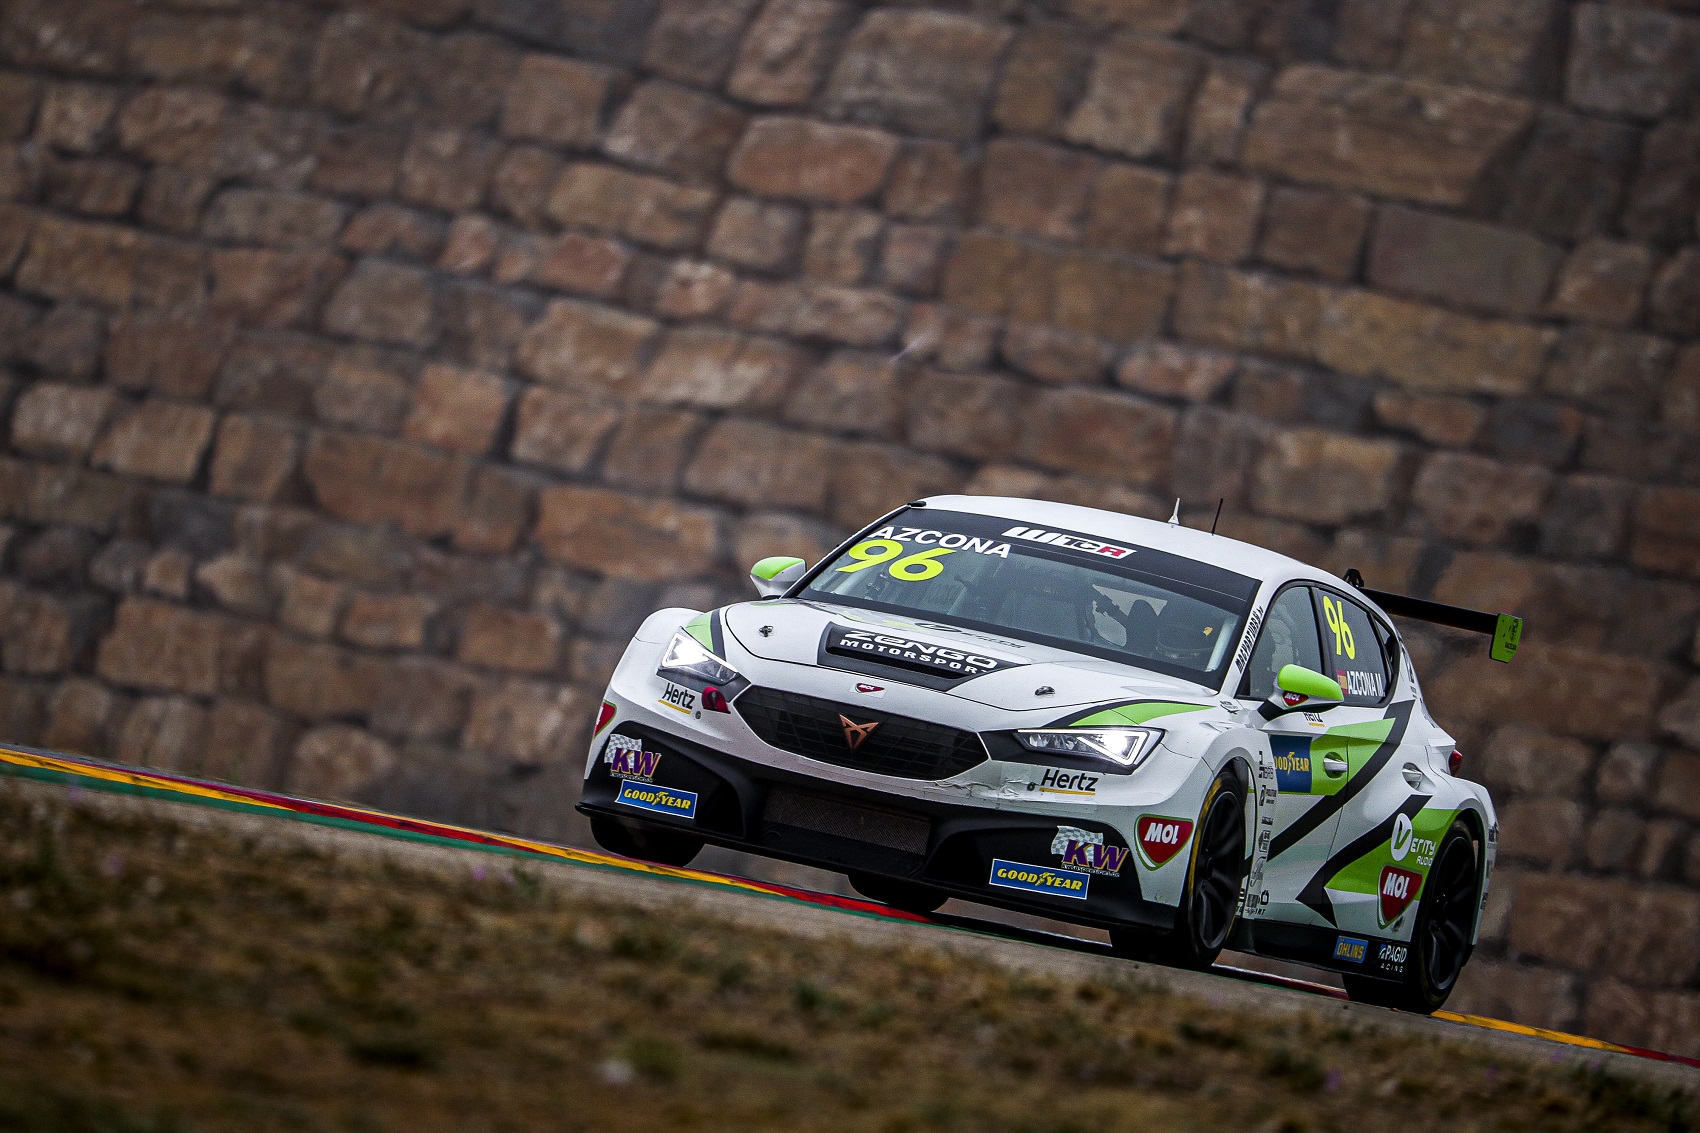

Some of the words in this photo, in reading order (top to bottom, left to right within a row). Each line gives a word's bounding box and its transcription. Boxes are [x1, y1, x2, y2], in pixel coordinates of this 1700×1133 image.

[869, 526, 1012, 559] AZCONA
[836, 539, 957, 581] 96
[1323, 595, 1356, 660] 96
[661, 682, 696, 710] Hertz
[1347, 670, 1378, 697] AZCONA
[611, 747, 662, 778] KW
[1273, 756, 1310, 772] OODYEAR
[1040, 768, 1099, 792] Hertz
[623, 788, 691, 810] GOODYEAR
[1144, 822, 1180, 845] MOL
[1062, 839, 1130, 873] KW
[997, 867, 1083, 891] GOODYEAR
[1382, 872, 1410, 900] MOL
